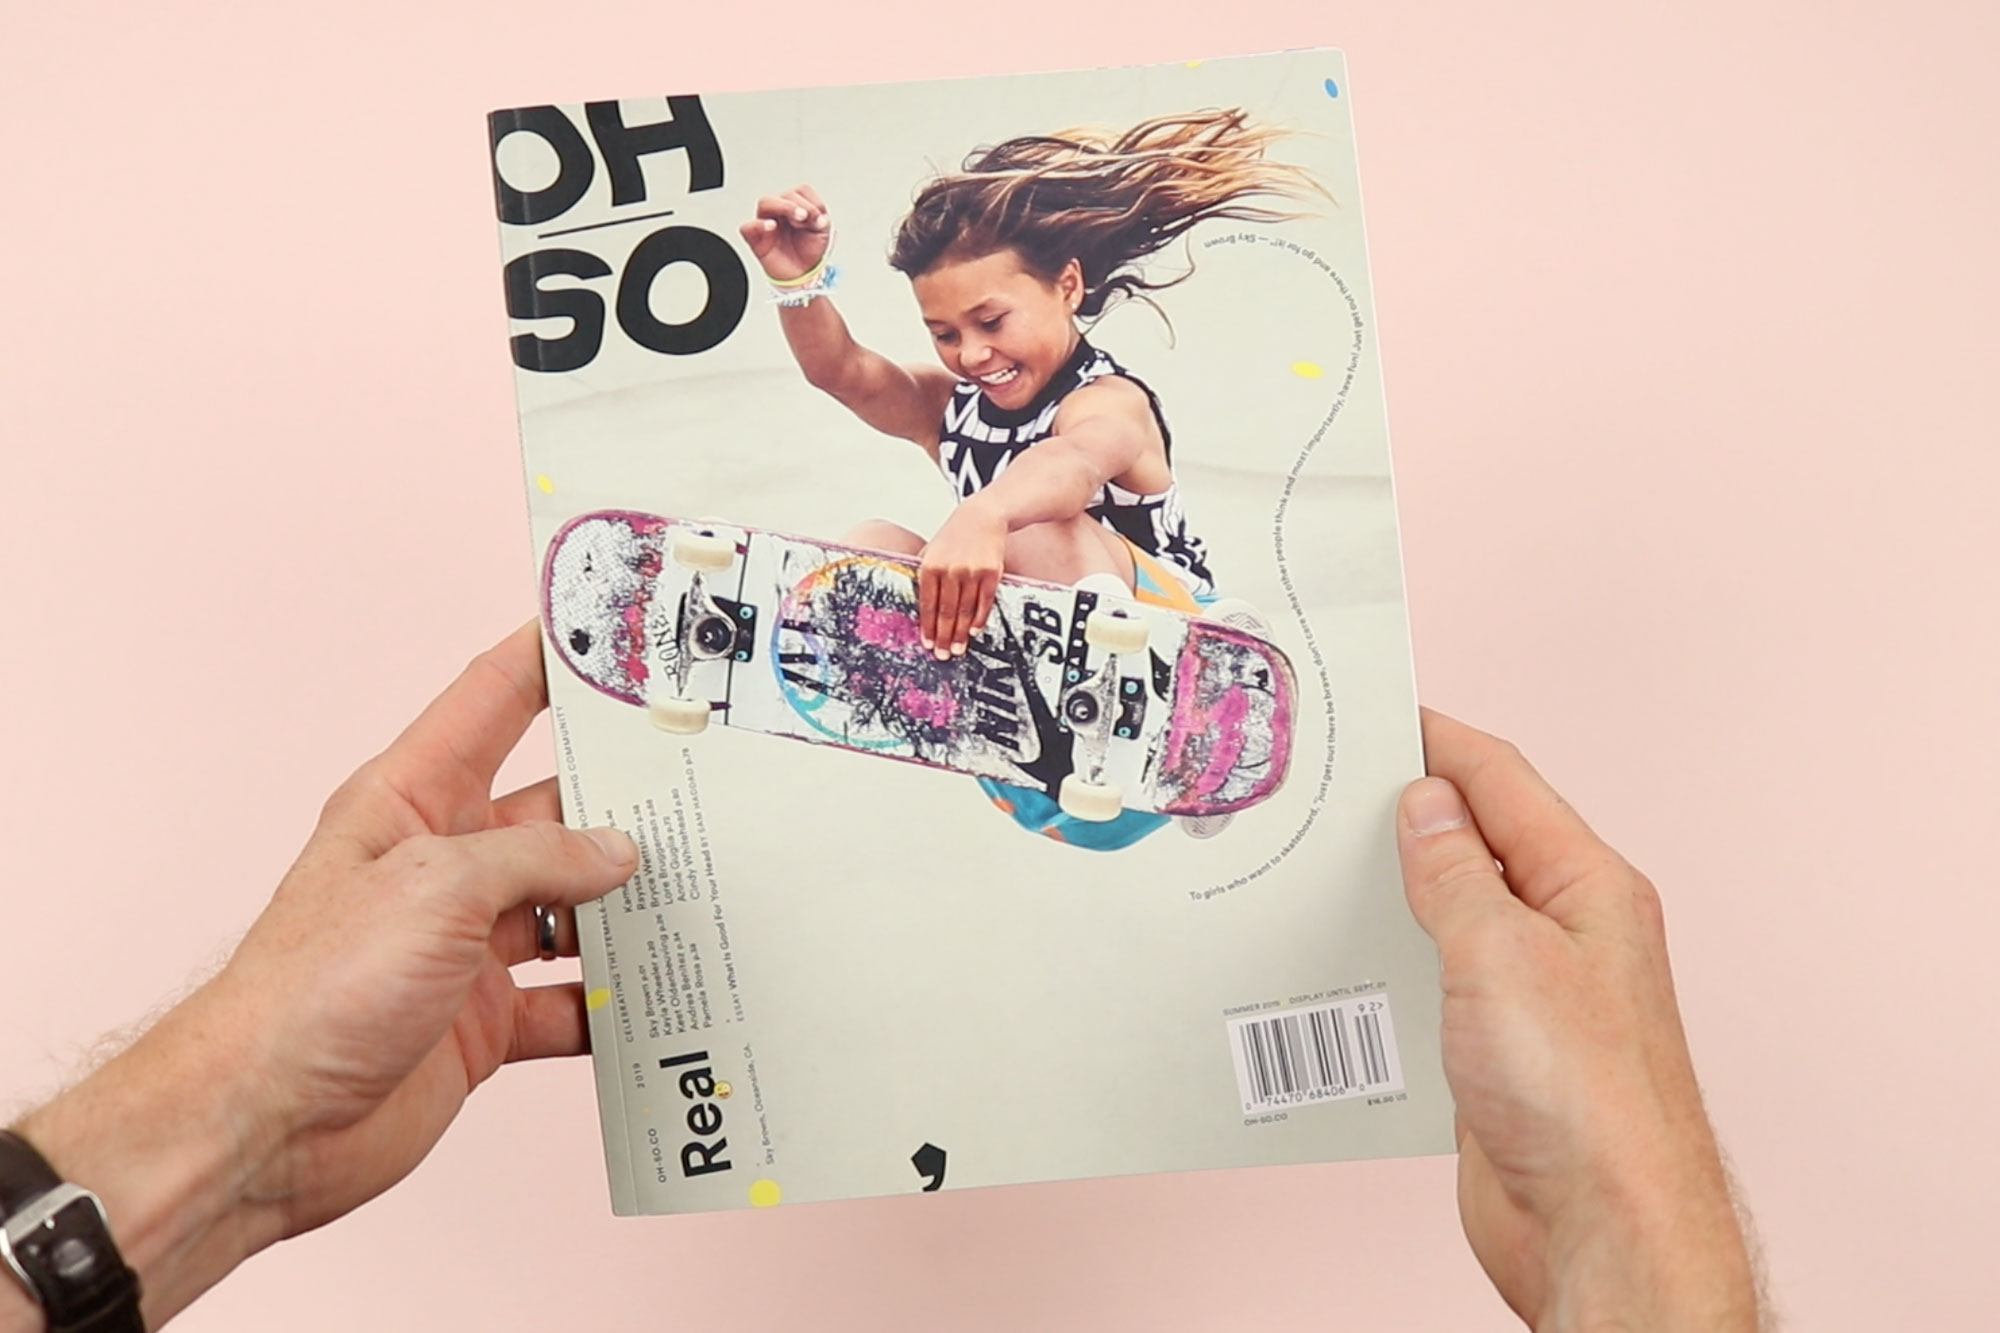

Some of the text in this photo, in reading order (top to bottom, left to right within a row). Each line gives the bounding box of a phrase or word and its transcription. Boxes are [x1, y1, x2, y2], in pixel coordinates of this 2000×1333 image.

[488, 94, 725, 226] OH
[1204, 235, 1236, 248] Brown
[1238, 232, 1257, 243] Sky
[1287, 243, 1301, 254] for
[1301, 249, 1316, 260] go
[1312, 257, 1331, 272] and
[1329, 271, 1349, 296] there
[504, 225, 749, 373] SO
[1345, 295, 1358, 311] out
[1351, 311, 1363, 328] get
[1352, 330, 1363, 352] Just
[1346, 352, 1359, 373] fun!
[1338, 373, 1354, 397] have
[1303, 399, 1345, 452] importantly,
[1291, 451, 1309, 476] most
[1283, 476, 1296, 496] and
[1274, 498, 1288, 523] think
[1272, 525, 1286, 562] people
[1279, 564, 1293, 592] other
[1287, 592, 1303, 617] what
[1023, 601, 1065, 665] SB
[1299, 618, 1314, 640] care
[966, 632, 1019, 752] NIKE
[1319, 667, 1334, 700] brave,
[1325, 701, 1335, 714] be
[554, 705, 577, 772] COMMUNITY
[1326, 715, 1336, 743] there
[1327, 745, 1335, 762] out
[1322, 763, 1333, 781] get
[685, 767, 701, 810] HADDAD
[694, 811, 707, 834] SAM
[1280, 807, 1321, 858] skateboard,
[635, 824, 653, 877] Wettstein
[649, 818, 670, 881] Bruggeman
[672, 808, 694, 868] Whitehead
[699, 836, 709, 849] BY
[666, 834, 681, 871] Guglia
[700, 849, 715, 878] Head
[1270, 855, 1282, 866] to
[1226, 877, 1248, 891] who
[1248, 862, 1272, 880] want
[633, 876, 646, 910] Rayssa
[647, 877, 661, 909] Bryce
[661, 880, 675, 906] Lore
[673, 871, 688, 903] Annie
[686, 868, 701, 901] Cindy
[708, 878, 720, 903] Your
[1189, 891, 1202, 900] To
[1203, 883, 1226, 900] girls
[712, 903, 724, 921] For
[598, 906, 614, 949] FEMALE
[715, 921, 730, 951] Good
[606, 950, 618, 971] THE
[722, 951, 732, 962] Is
[650, 961, 667, 1007] Wheeler
[693, 962, 705, 989] Rosa
[724, 962, 738, 991] What
[611, 972, 635, 1044] CELEBRATING
[641, 983, 656, 1018] Brown
[697, 989, 713, 1029] Pamela
[731, 993, 745, 1023] ESSAY
[1222, 1002, 1261, 1016] SUMMER
[1289, 991, 1324, 1005] DISPLAY
[1326, 987, 1352, 998] UNTIL
[659, 1006, 673, 1037] Kayla
[685, 992, 700, 1031] Andrea
[648, 1019, 660, 1039] Sky
[631, 1062, 668, 1184] OH-SO.CO 2019
[659, 1051, 732, 1178] Real
[765, 1147, 775, 1166] Sky
